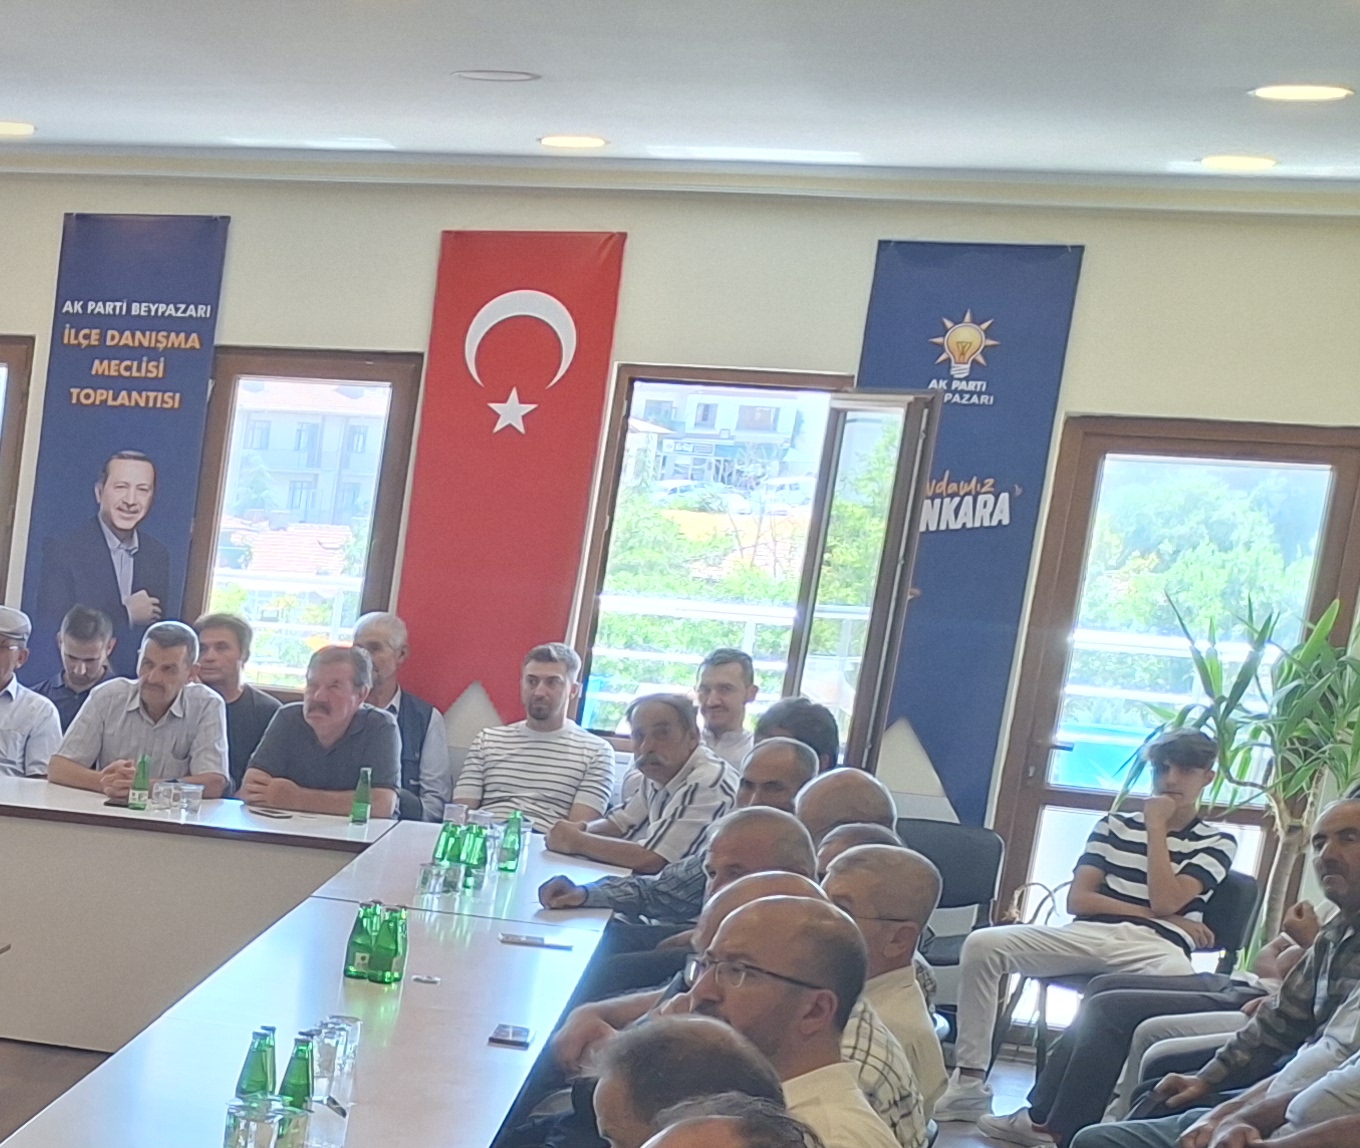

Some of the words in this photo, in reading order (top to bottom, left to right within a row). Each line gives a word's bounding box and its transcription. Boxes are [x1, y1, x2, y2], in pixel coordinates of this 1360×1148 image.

[62, 300, 84, 314] AK
[87, 299, 127, 315] PARTİ
[131, 302, 211, 318] BEYPAZARI
[63, 323, 101, 349] İLÇE
[105, 329, 201, 351] DANIŞMA
[91, 356, 165, 378] MECLİSİ
[928, 379, 949, 390] AK
[70, 387, 181, 409] TOPLANTISI
[943, 393, 994, 406] PAZARI
[926, 469, 995, 497] vdamız
[919, 492, 1010, 533] NKARA
